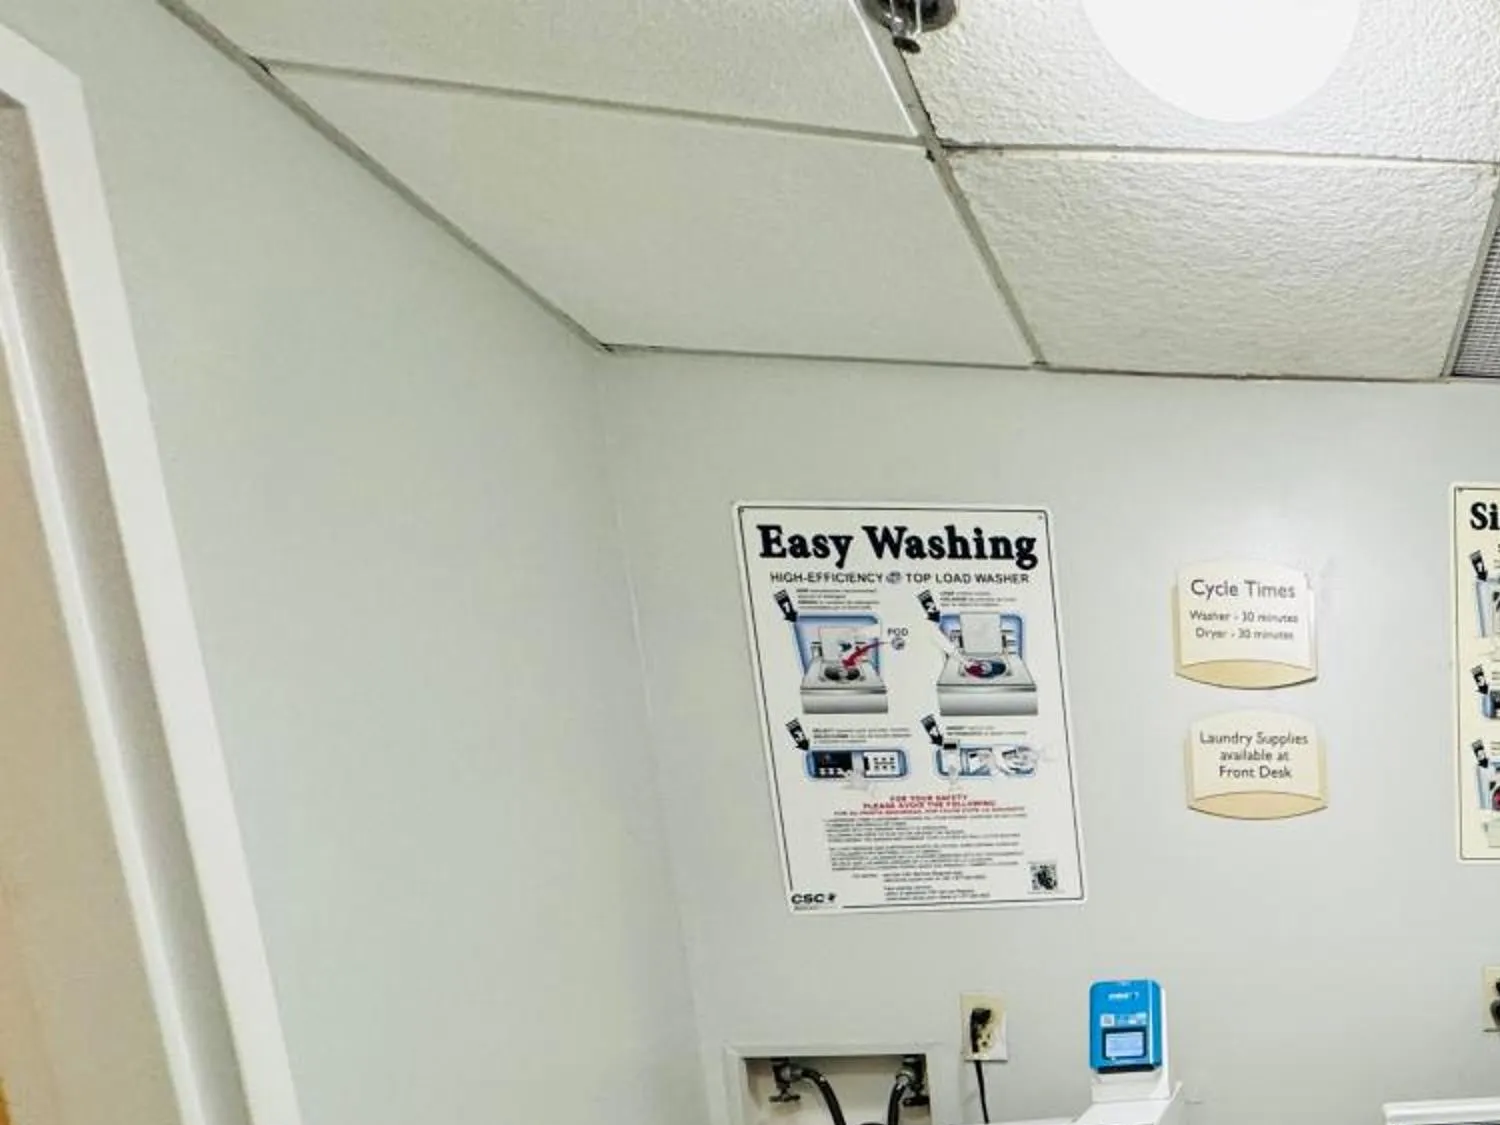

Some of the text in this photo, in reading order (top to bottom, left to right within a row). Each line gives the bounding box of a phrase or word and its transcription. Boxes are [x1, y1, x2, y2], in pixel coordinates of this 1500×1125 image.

[757, 524, 1038, 570] Easy Washing
[770, 571, 1029, 584] HIGH-EFFICIENCY TOP LOAD WASHER
[1190, 578, 1296, 600] Cycle Times
[1257, 611, 1298, 624] minutes
[887, 627, 909, 637] POD
[1195, 627, 1228, 641] Dryer
[1253, 629, 1294, 641] minutes
[1199, 731, 1309, 748] Laundry Supplies
[1219, 748, 1290, 762] available at
[1218, 764, 1293, 779] Front Desk
[790, 893, 826, 905] CSC
